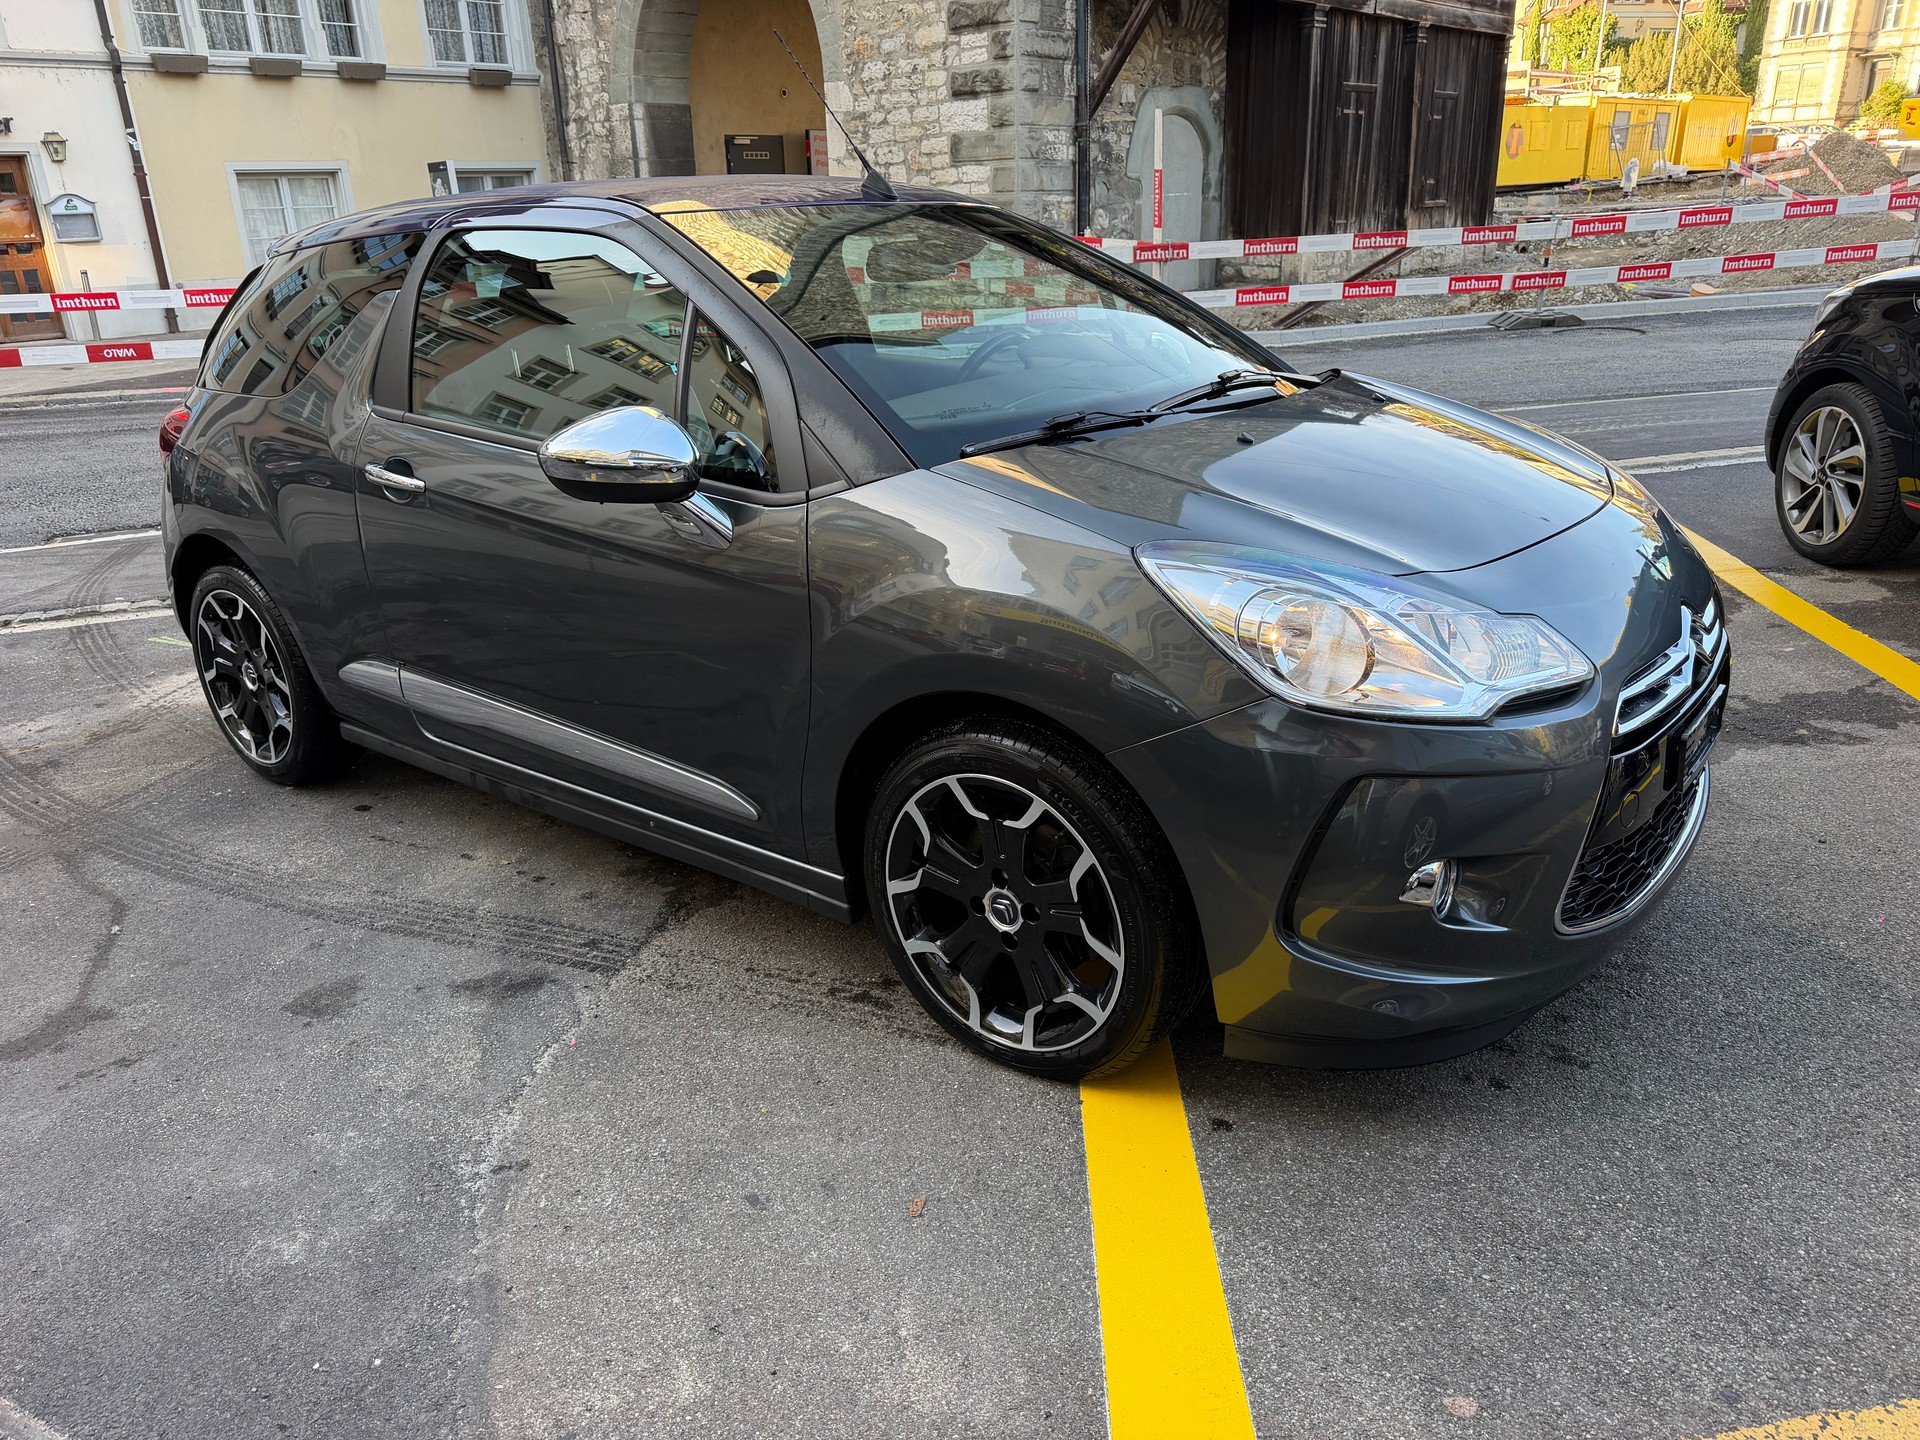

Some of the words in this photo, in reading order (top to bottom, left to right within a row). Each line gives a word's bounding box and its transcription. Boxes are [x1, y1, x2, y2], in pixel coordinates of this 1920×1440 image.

[1135, 246, 1187, 262] Imthurn
[1245, 241, 1296, 255] Imthurn
[1355, 235, 1406, 248] Imthurn
[1464, 229, 1516, 243] Imthurn
[1574, 220, 1623, 234] Imthurn
[1680, 211, 1730, 225] Imthurn
[1786, 201, 1834, 216] Imthurn
[1891, 195, 1920, 206] Imth
[1513, 275, 1563, 289] Imthurn
[1619, 266, 1668, 280] Imthurn
[1723, 257, 1772, 270] Imthurn
[1827, 247, 1875, 261] Imthurn
[1238, 291, 1287, 303] Imthurn
[1344, 284, 1393, 297] Imthurn
[1450, 278, 1499, 291] Imthurn
[54, 296, 117, 309] Imthurn
[923, 315, 970, 326] Imthurn
[103, 347, 137, 358] WALO
